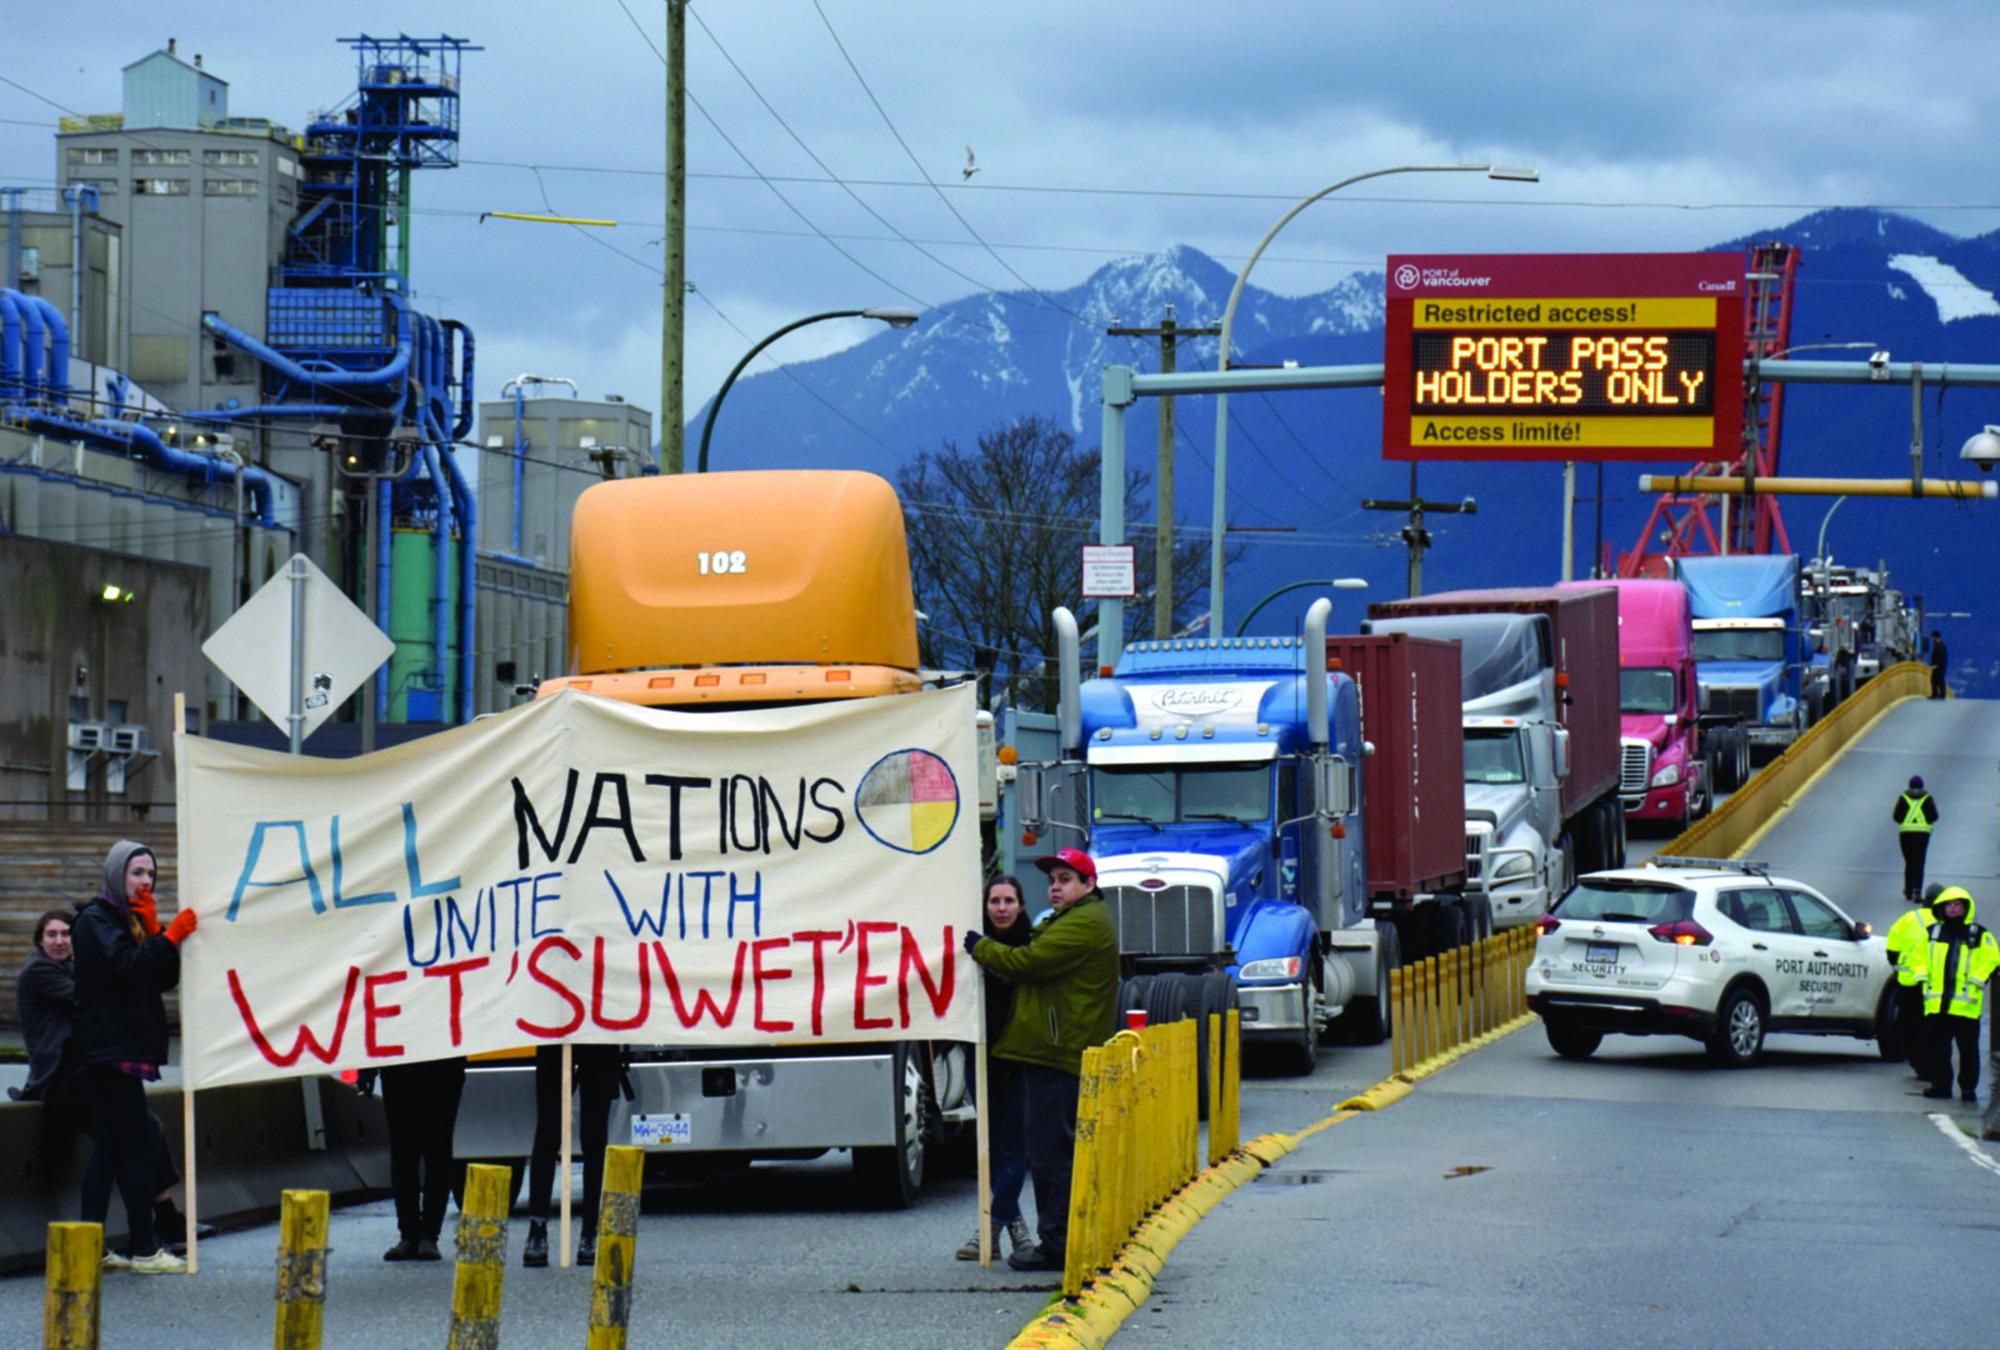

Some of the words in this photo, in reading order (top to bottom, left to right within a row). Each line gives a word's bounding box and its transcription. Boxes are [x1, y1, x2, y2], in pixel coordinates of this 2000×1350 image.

[1422, 269, 1448, 277] PORT
[1423, 277, 1492, 287] vancouver
[1424, 303, 1541, 323] Restricted
[1548, 303, 1636, 322] access!
[1452, 336, 1548, 370] PORT
[1571, 336, 1669, 370] PASS
[1415, 370, 1583, 404] HOLDERS
[1606, 370, 1704, 404] ONLY
[1422, 422, 1505, 441] Access
[1512, 421, 1581, 441] limité!
[697, 550, 747, 575] 102
[227, 801, 461, 922] ALL
[511, 768, 847, 870] NATIONS
[403, 870, 563, 968] UNITE
[604, 870, 762, 940] WITH
[1571, 962, 1627, 975] SECURITY
[1776, 959, 1803, 975] PORT
[1807, 961, 1869, 978] AUTHORITY
[1799, 979, 1842, 995] SECURITY
